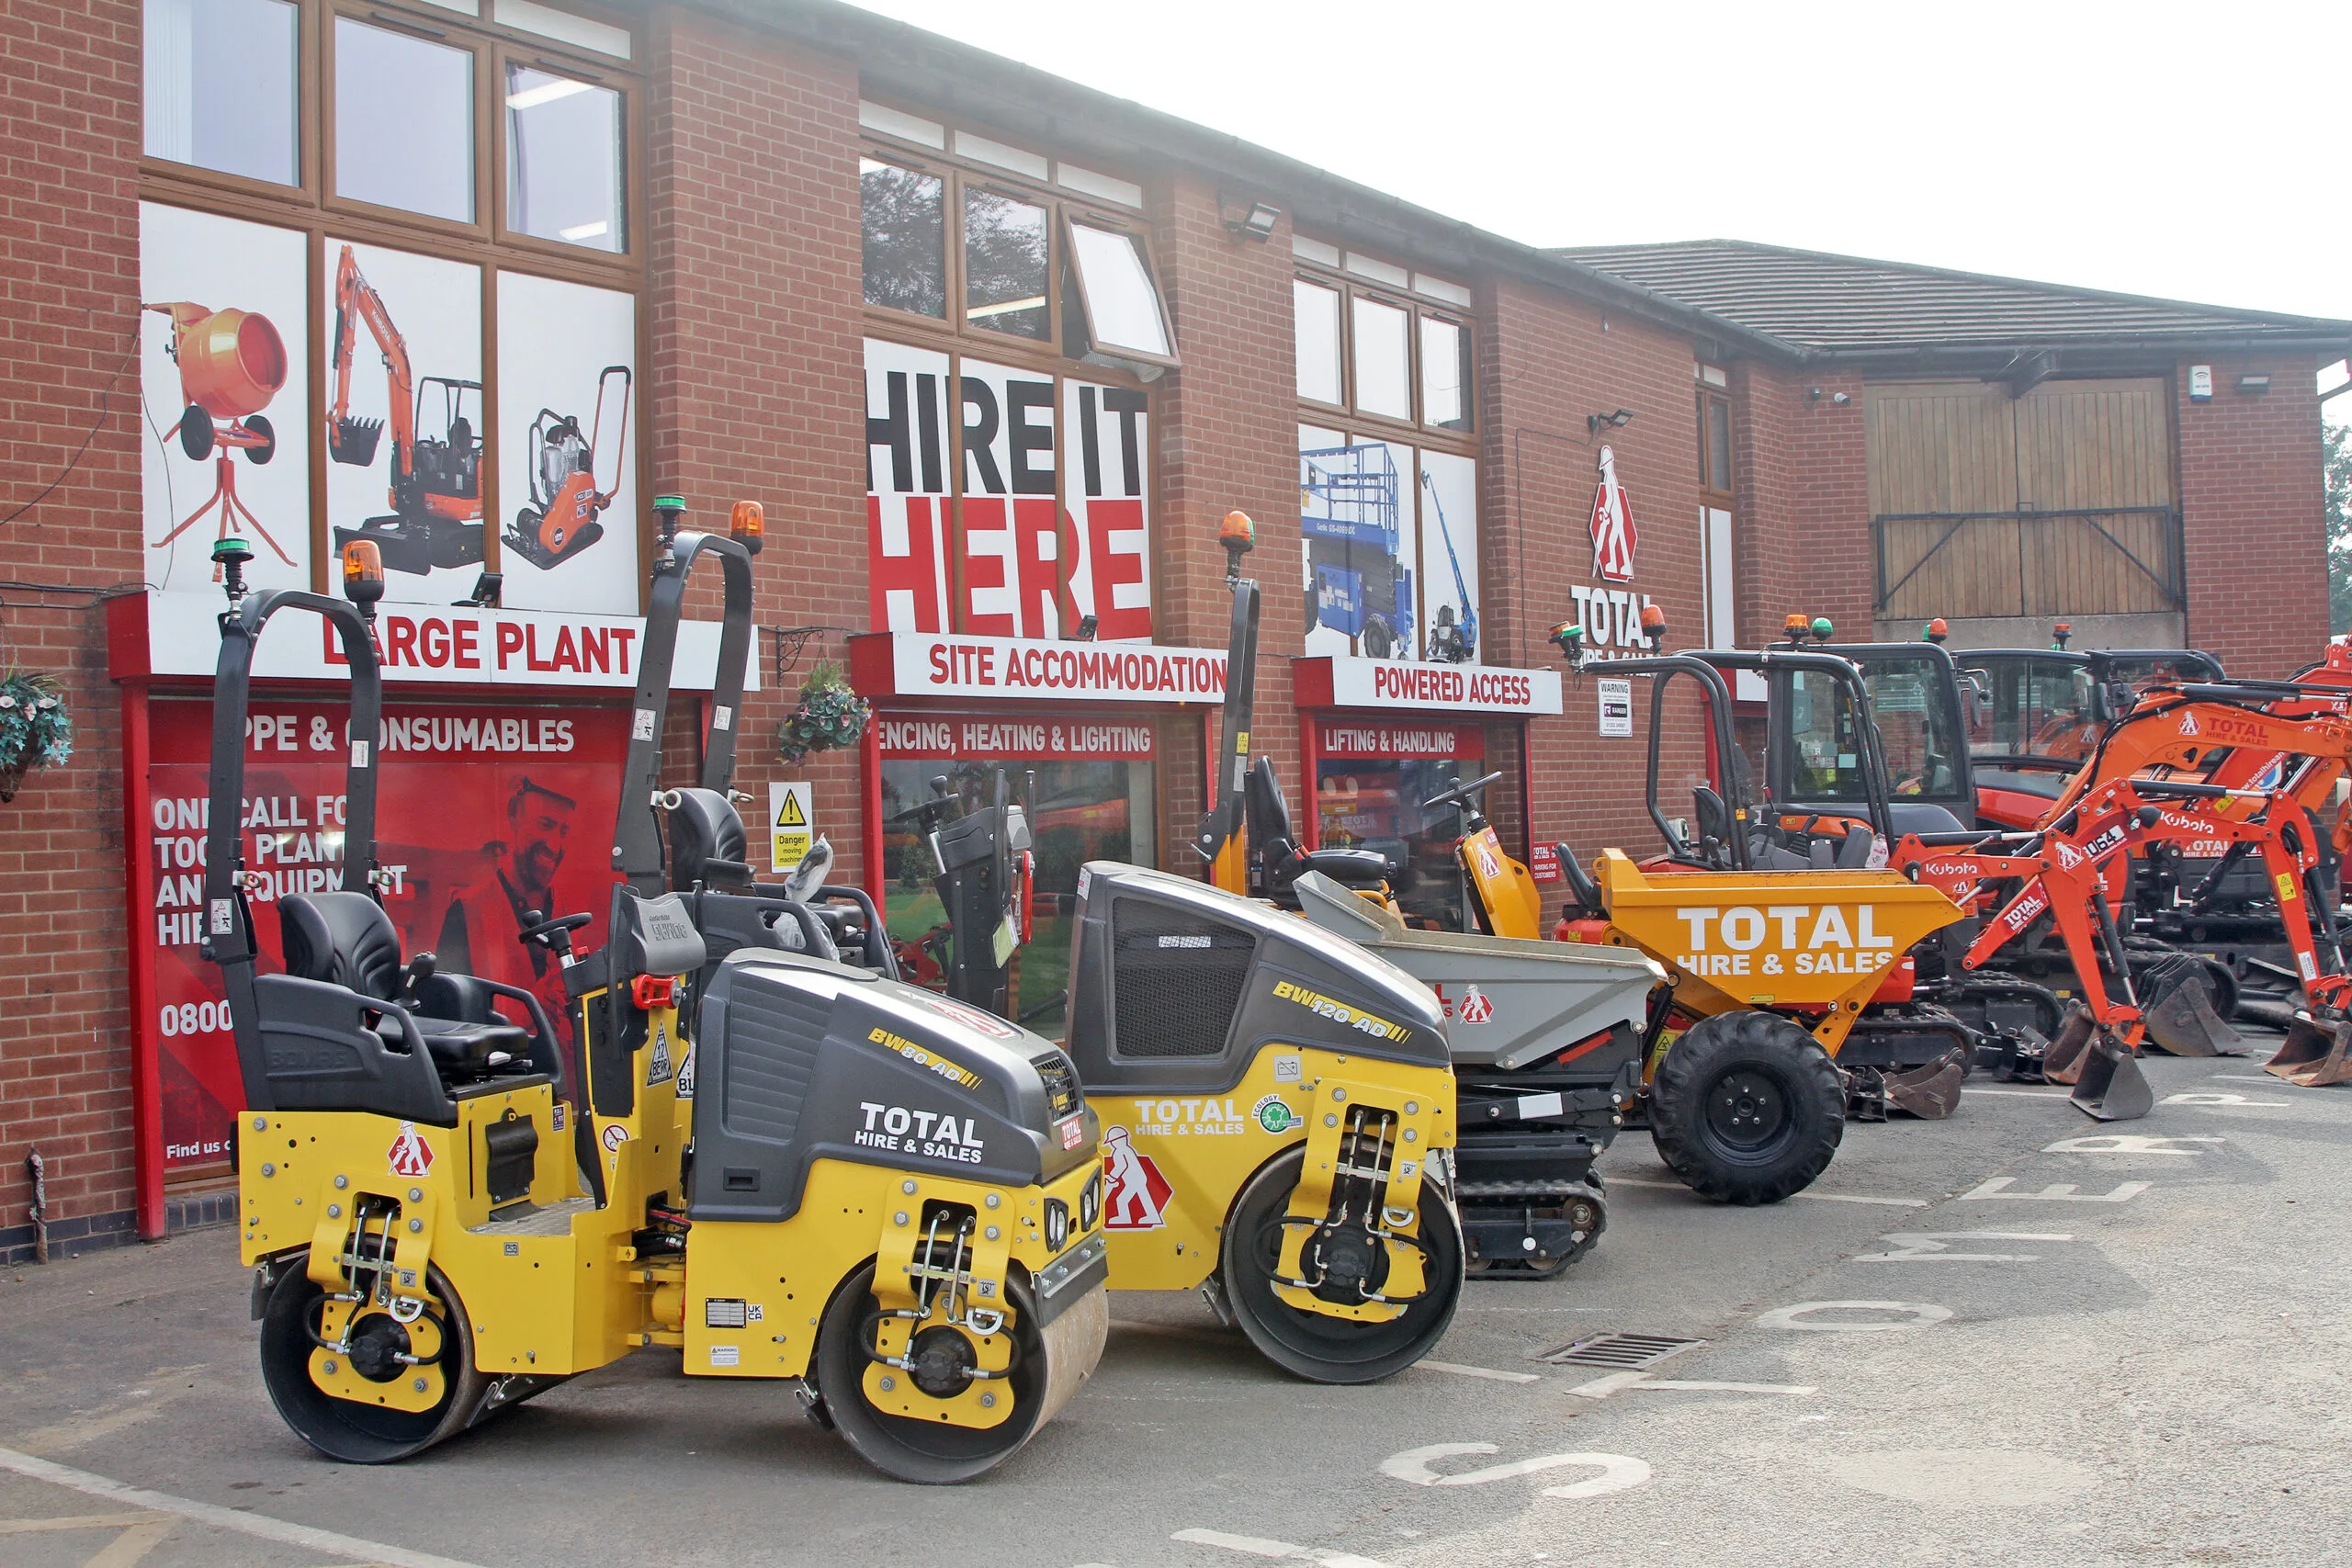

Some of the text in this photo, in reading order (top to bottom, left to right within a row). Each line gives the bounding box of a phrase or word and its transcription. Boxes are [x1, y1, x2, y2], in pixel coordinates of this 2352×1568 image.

[865, 369, 1148, 496] HIRE IT
[867, 495, 1153, 641] HERE
[496, 622, 636, 674] PLANT
[929, 643, 1227, 694] SITE ACCOMMODATION
[1374, 666, 1531, 705] POWERED ACCESS
[1601, 683, 1629, 694] WARNING
[245, 715, 575, 752] PE & NSUMABLES
[879, 721, 1151, 756] ENCING, HEATING & LIGHTING
[2206, 731, 2227, 740] HIRE
[2240, 735, 2268, 747] SALES
[2208, 717, 2268, 739] TOTAL
[1325, 728, 1455, 753] LIFTING & HANDLING
[2160, 811, 2214, 834] Kubota
[779, 836, 806, 846] Danger
[1926, 863, 1977, 875] Kubota
[155, 874, 207, 908] AN
[2004, 896, 2041, 926] TOTAL
[2011, 918, 2024, 931] HIRE
[2026, 901, 2044, 920] SALES
[1677, 905, 1894, 951] TOTAL
[1677, 952, 1894, 976] HIRE & SALES
[161, 999, 233, 1037] 0800
[1352, 1016, 1389, 1039] AD
[656, 1043, 665, 1059] 12
[930, 1061, 960, 1082] AD
[1135, 1100, 1244, 1122] TOTAL
[1253, 1094, 1278, 1117] ECOLOGY
[861, 1101, 984, 1148] TOTAL
[1062, 1120, 1081, 1141] TOTAL
[1136, 1123, 1244, 1135] HIRE & SALES
[166, 1142, 199, 1158] Find
[204, 1140, 220, 1154] us
[854, 1130, 982, 1164] HIRE & SALES
